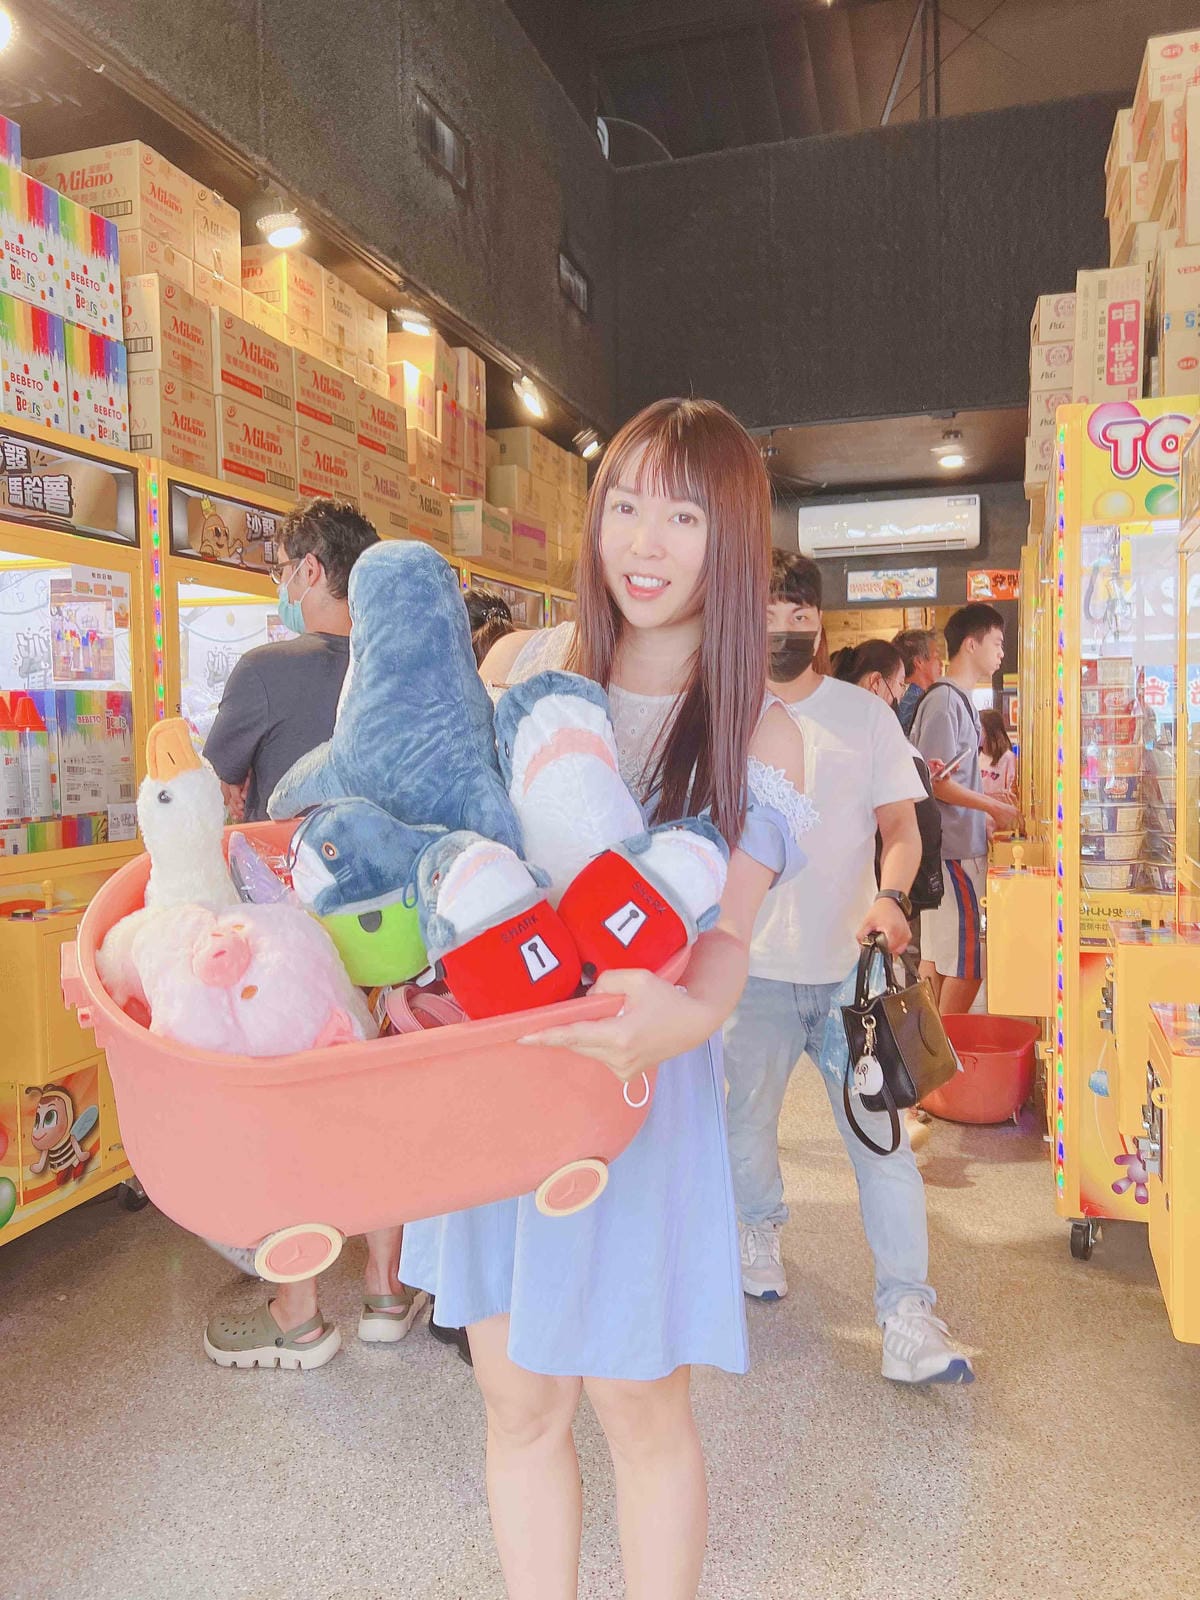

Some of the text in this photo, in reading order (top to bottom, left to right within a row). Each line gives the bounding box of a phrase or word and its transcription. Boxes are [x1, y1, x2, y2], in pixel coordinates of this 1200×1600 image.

[56, 169, 113, 192] Milano
[149, 182, 183, 215] Milano
[5, 240, 38, 262] BEBETO
[10, 264, 36, 288] Bears
[71, 272, 100, 292] BEBETO
[75, 294, 98, 316] Bears
[170, 316, 204, 346] Milano
[237, 336, 279, 372] Milano
[11, 372, 43, 391] BEBETO
[312, 370, 345, 400] Milano
[16, 395, 41, 416] Bears
[94, 404, 122, 420] BEBETO
[171, 411, 206, 438] Milano
[369, 404, 398, 432] Milano
[98, 424, 119, 442] Bears
[240, 423, 282, 455] Milano
[313, 450, 347, 478] Milano
[8, 475, 70, 515] 馬鈴薯
[371, 475, 400, 499] Milano
[419, 495, 442, 517] Milano
[246, 512, 275, 540] 沙發
[78, 715, 101, 724] BEBETO
[501, 914, 539, 943] SHARK
